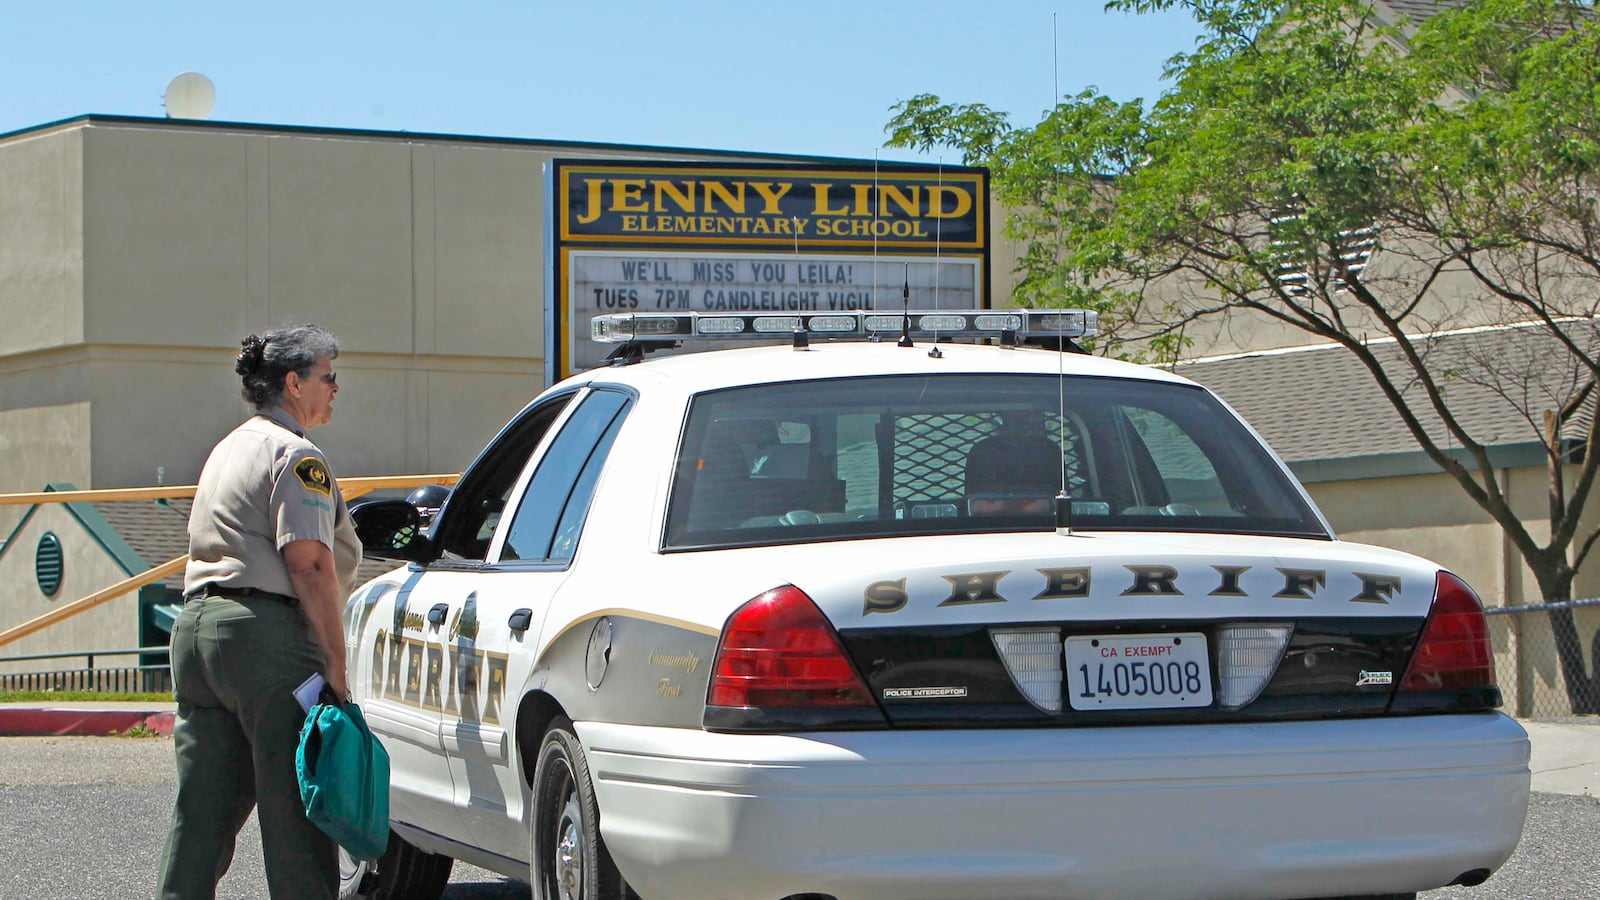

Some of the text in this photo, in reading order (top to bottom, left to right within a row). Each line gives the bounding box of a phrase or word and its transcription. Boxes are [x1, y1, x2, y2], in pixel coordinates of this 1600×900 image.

[577, 177, 973, 225] JENNY LIND
[622, 214, 929, 238] ELEMENTARY SCHOOL
[622, 260, 853, 284] WE'LL MISS YOU LEILA!
[594, 288, 874, 311] TUES 7PM CANDLELIGHT VIGIL
[862, 563, 1402, 617] SHERIFF
[649, 648, 700, 676] Community
[1100, 645, 1173, 658] CA EXEMPT
[372, 628, 509, 725] SHERIFF
[1079, 662, 1202, 698] 1405008
[914, 688, 965, 696] INTERCEPTOR
